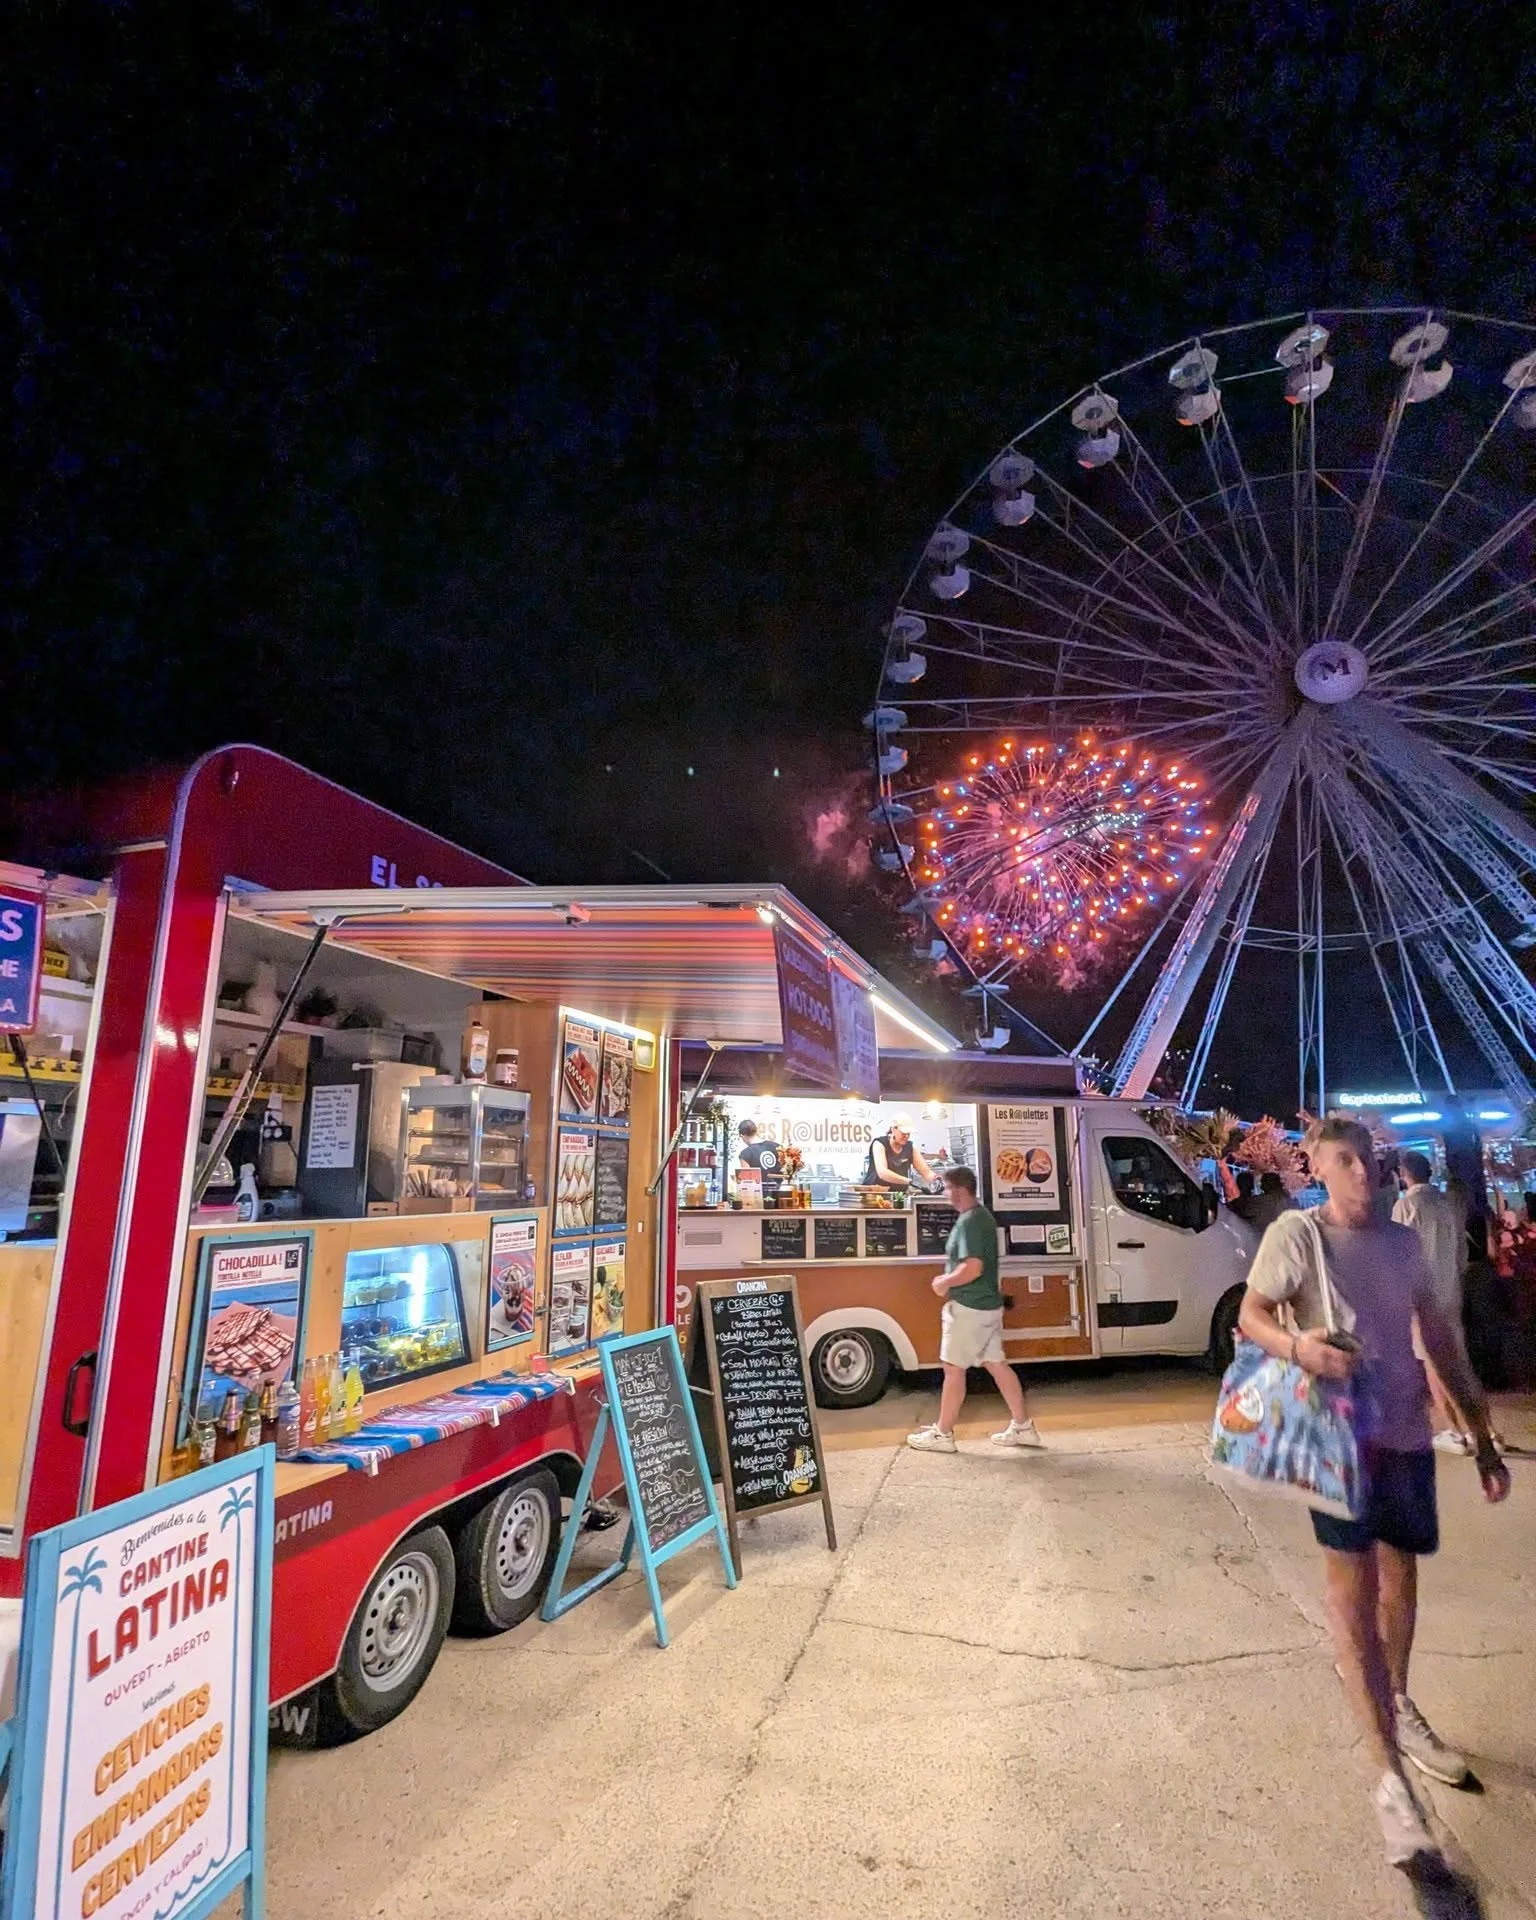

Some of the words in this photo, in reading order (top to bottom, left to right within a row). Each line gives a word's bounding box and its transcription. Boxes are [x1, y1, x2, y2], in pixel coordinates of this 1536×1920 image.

[371, 855, 400, 888] EL
[756, 1121, 776, 1142] es
[995, 1108, 1008, 1120] Les
[218, 1255, 277, 1272] CHOCADILLA
[187, 1515, 193, 1524] a
[196, 1509, 207, 1525] la
[119, 1531, 209, 1598] CANTINE
[87, 1558, 229, 1682] LATINA
[104, 1664, 155, 1707] OUVERT
[164, 1630, 210, 1667] ABIERTO
[95, 1683, 211, 1797] CEVICHES
[72, 1721, 224, 1873] EMPANADAS
[81, 1778, 211, 1919] CERVEZAS
